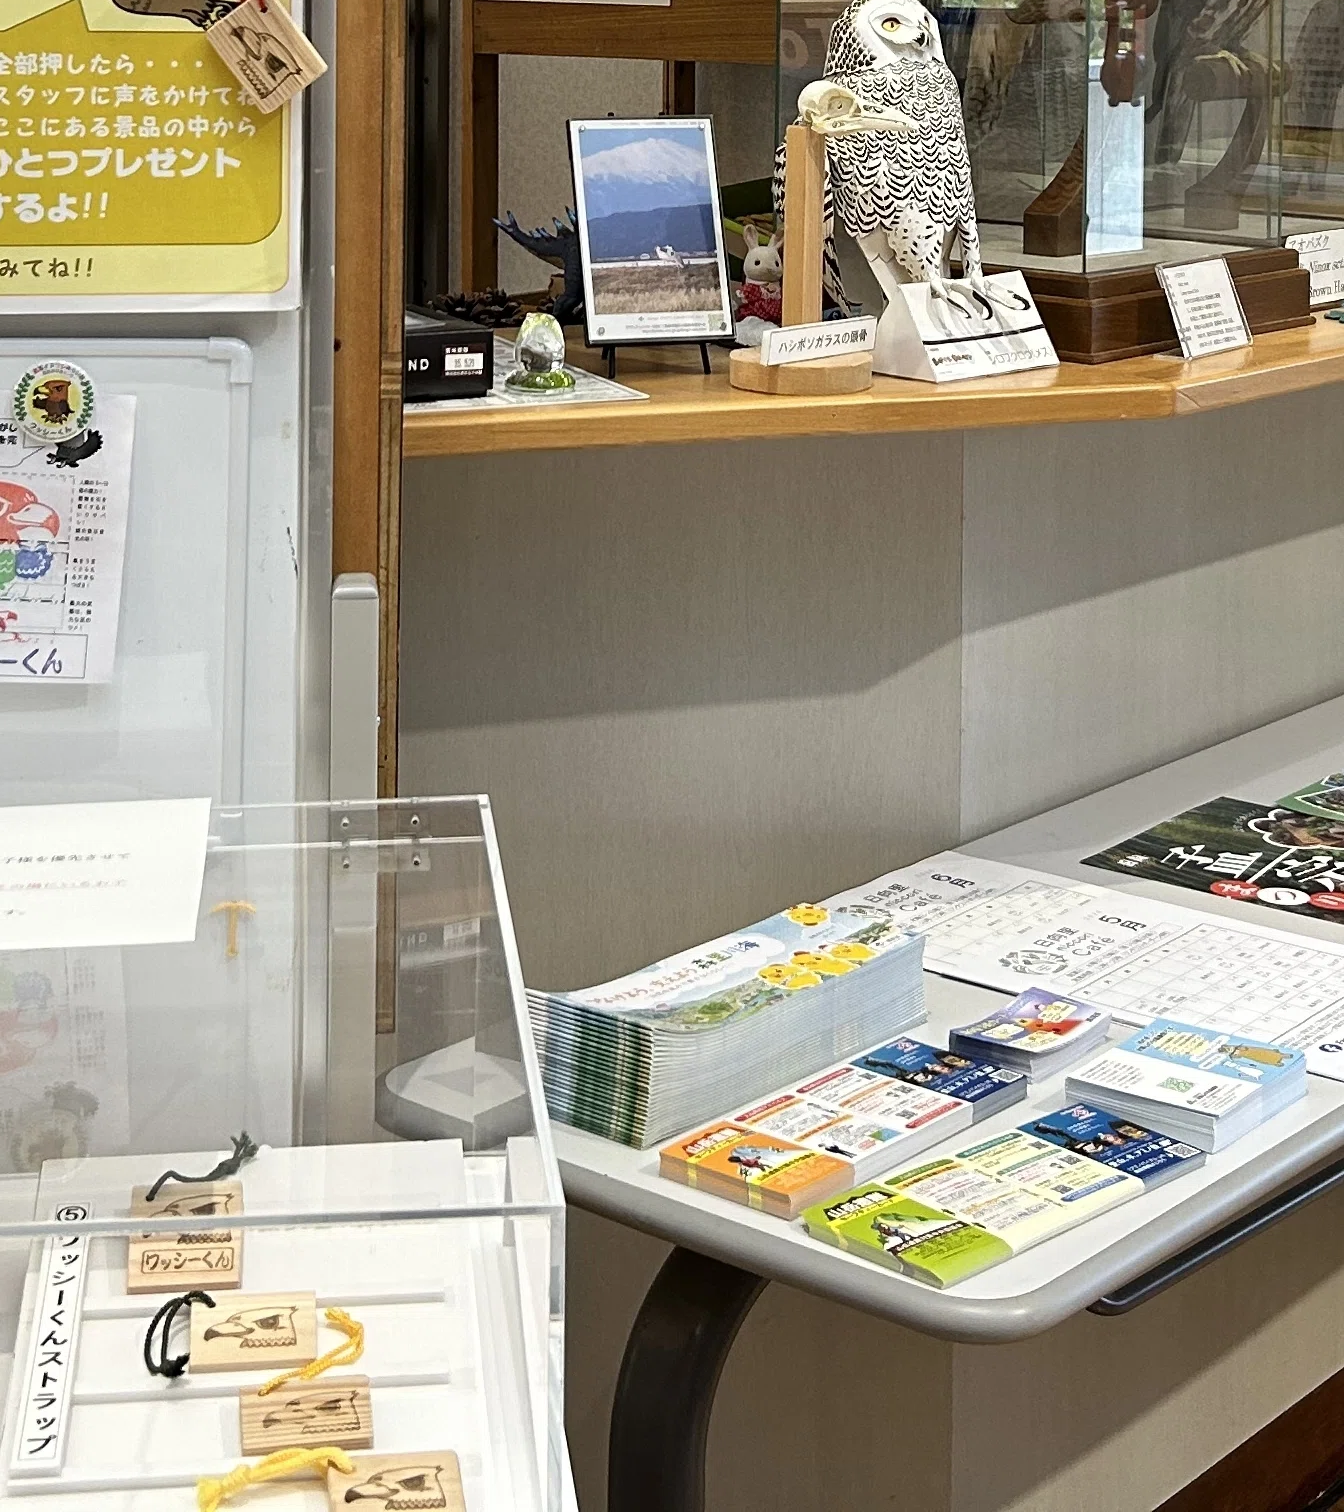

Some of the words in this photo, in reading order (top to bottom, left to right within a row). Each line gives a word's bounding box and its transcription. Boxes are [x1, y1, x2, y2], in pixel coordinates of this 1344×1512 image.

[778, 329, 868, 353] ハシボソガラスの頭骨
[898, 892, 944, 913] Café
[1098, 914, 1147, 932] 5月
[1071, 935, 1116, 958] Café
[144, 1248, 232, 1272] ワッシーくん
